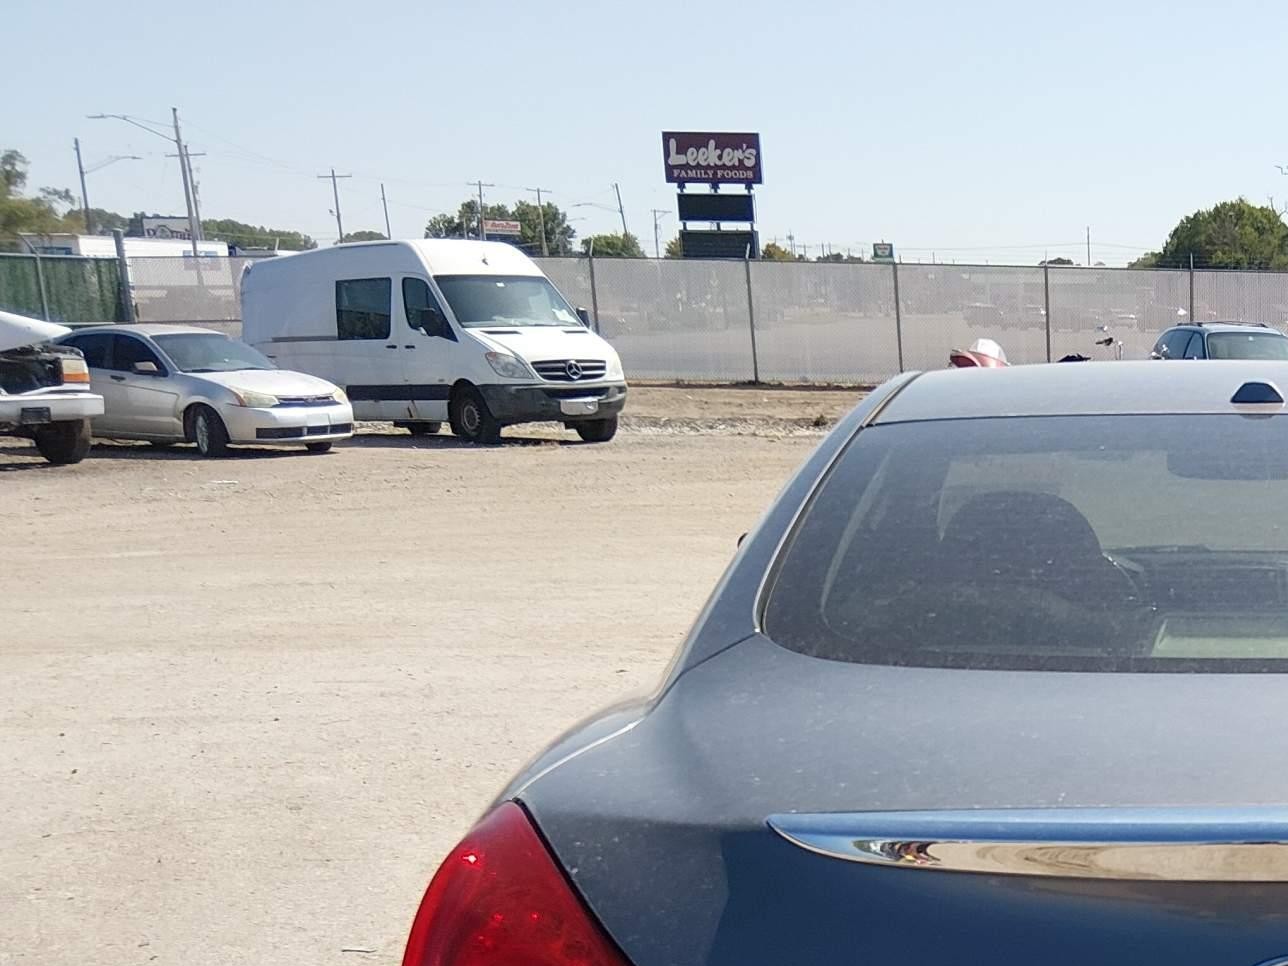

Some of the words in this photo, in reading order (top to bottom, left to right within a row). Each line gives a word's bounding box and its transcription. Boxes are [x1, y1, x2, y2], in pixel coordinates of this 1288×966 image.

[668, 138, 757, 167] Leeker's
[673, 169, 713, 179] FAMILY
[717, 169, 753, 179] FOODS
